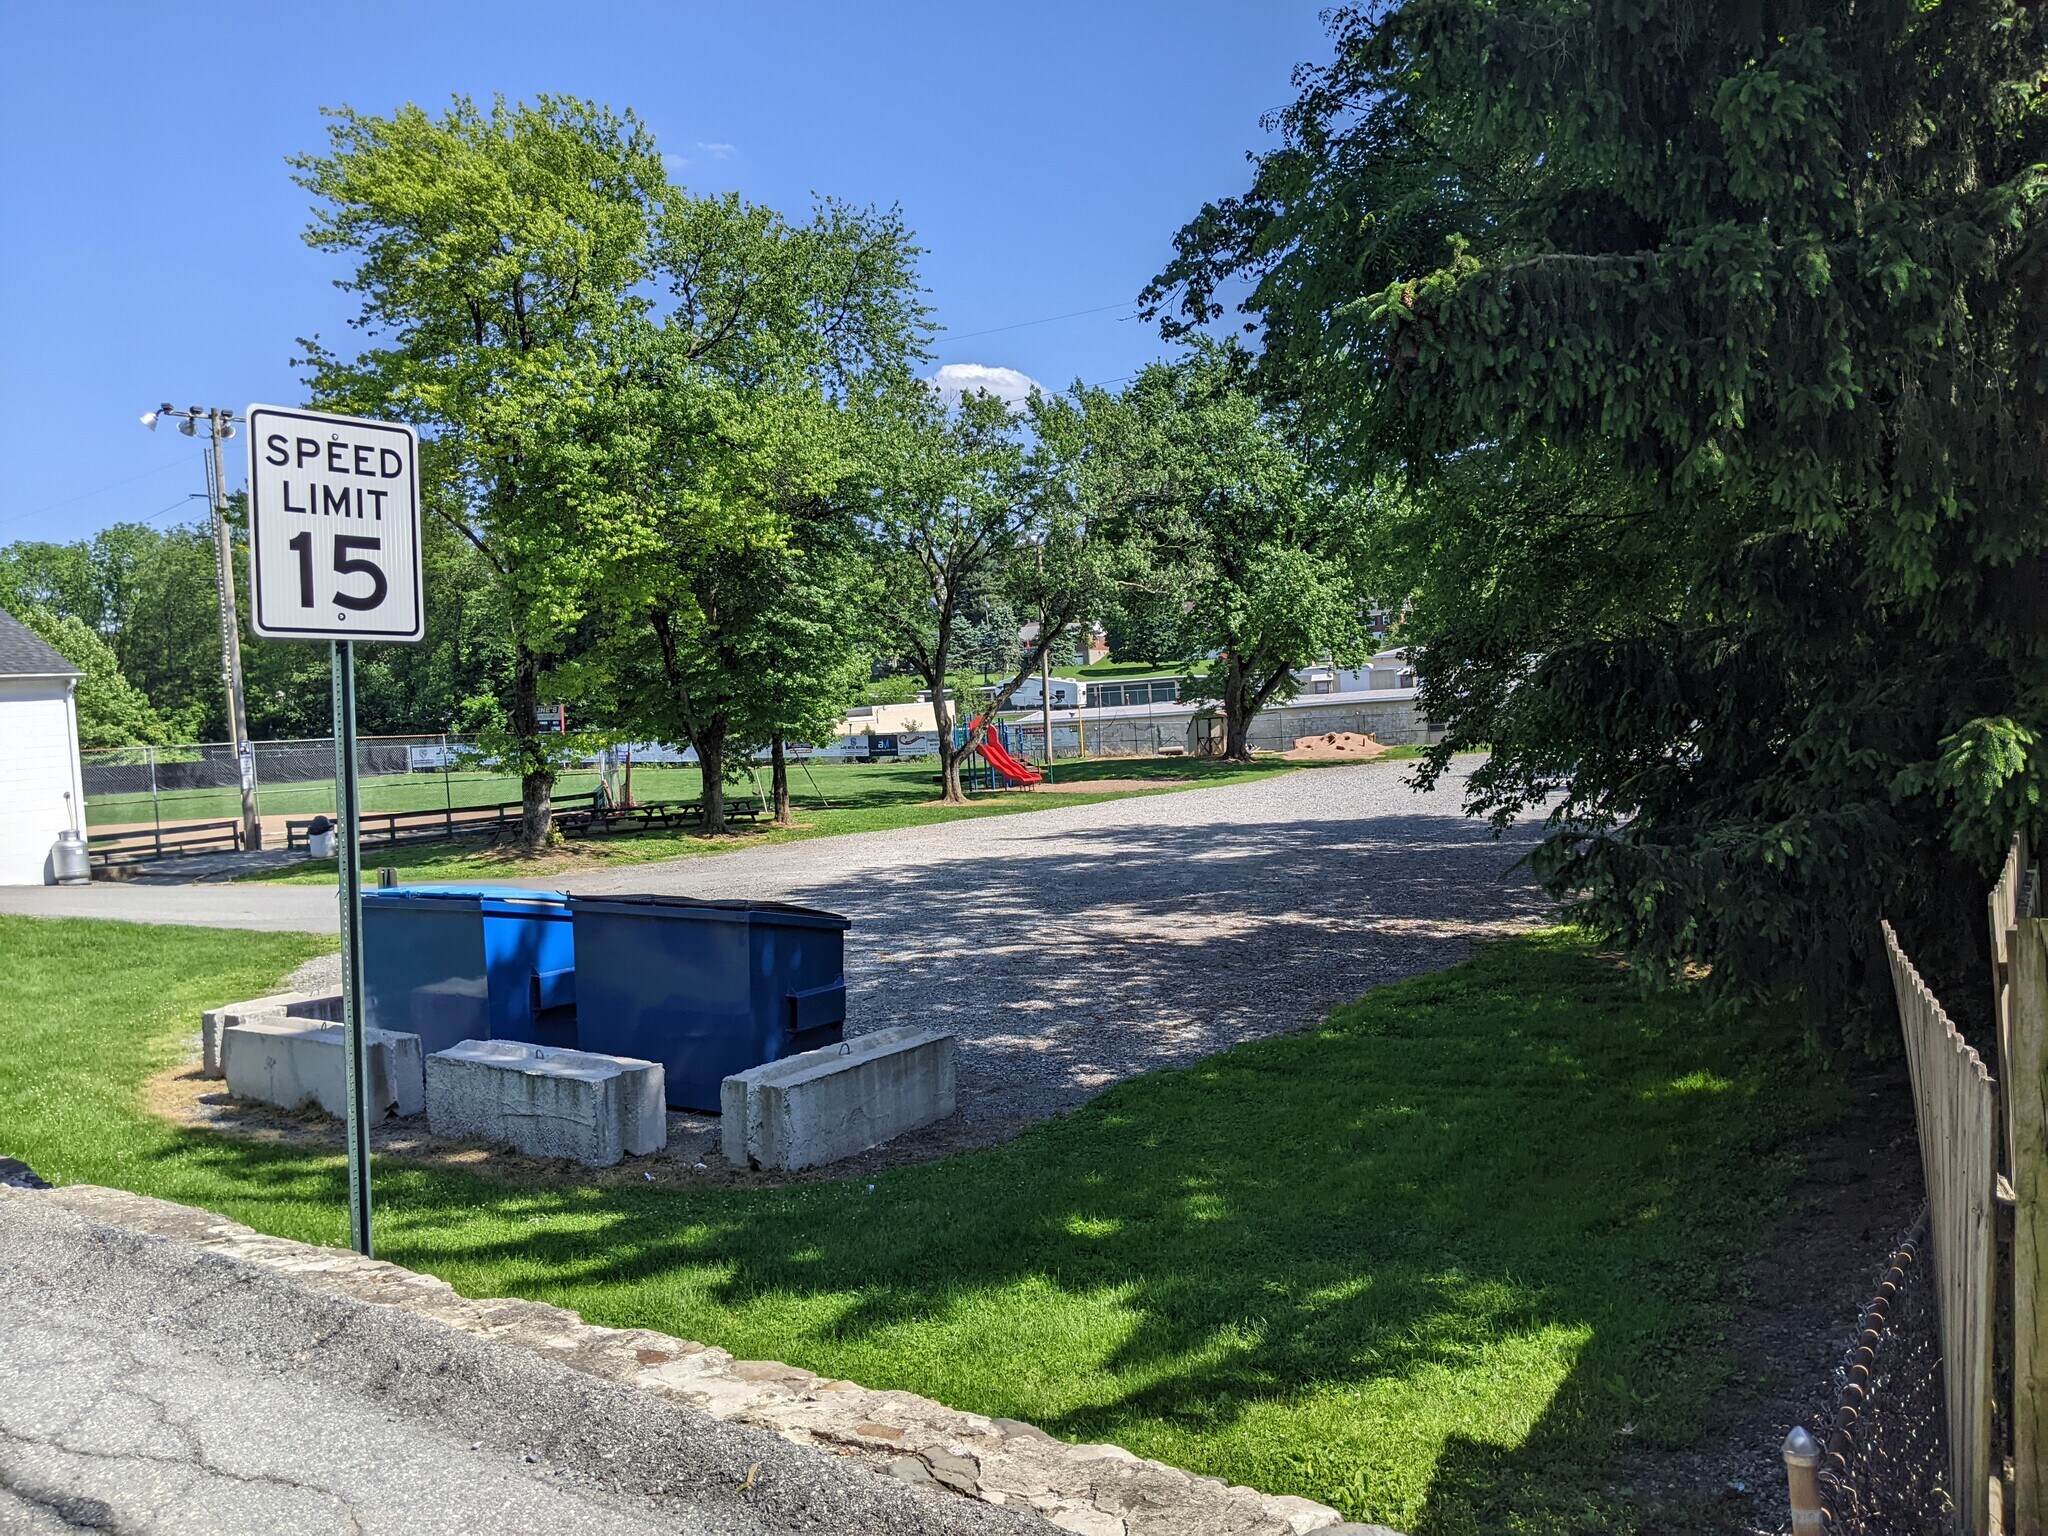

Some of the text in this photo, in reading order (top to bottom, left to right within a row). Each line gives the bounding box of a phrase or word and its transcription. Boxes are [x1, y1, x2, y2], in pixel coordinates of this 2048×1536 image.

[265, 433, 403, 479] SPEED
[283, 480, 389, 521] LIMIT
[289, 531, 388, 611] 15
